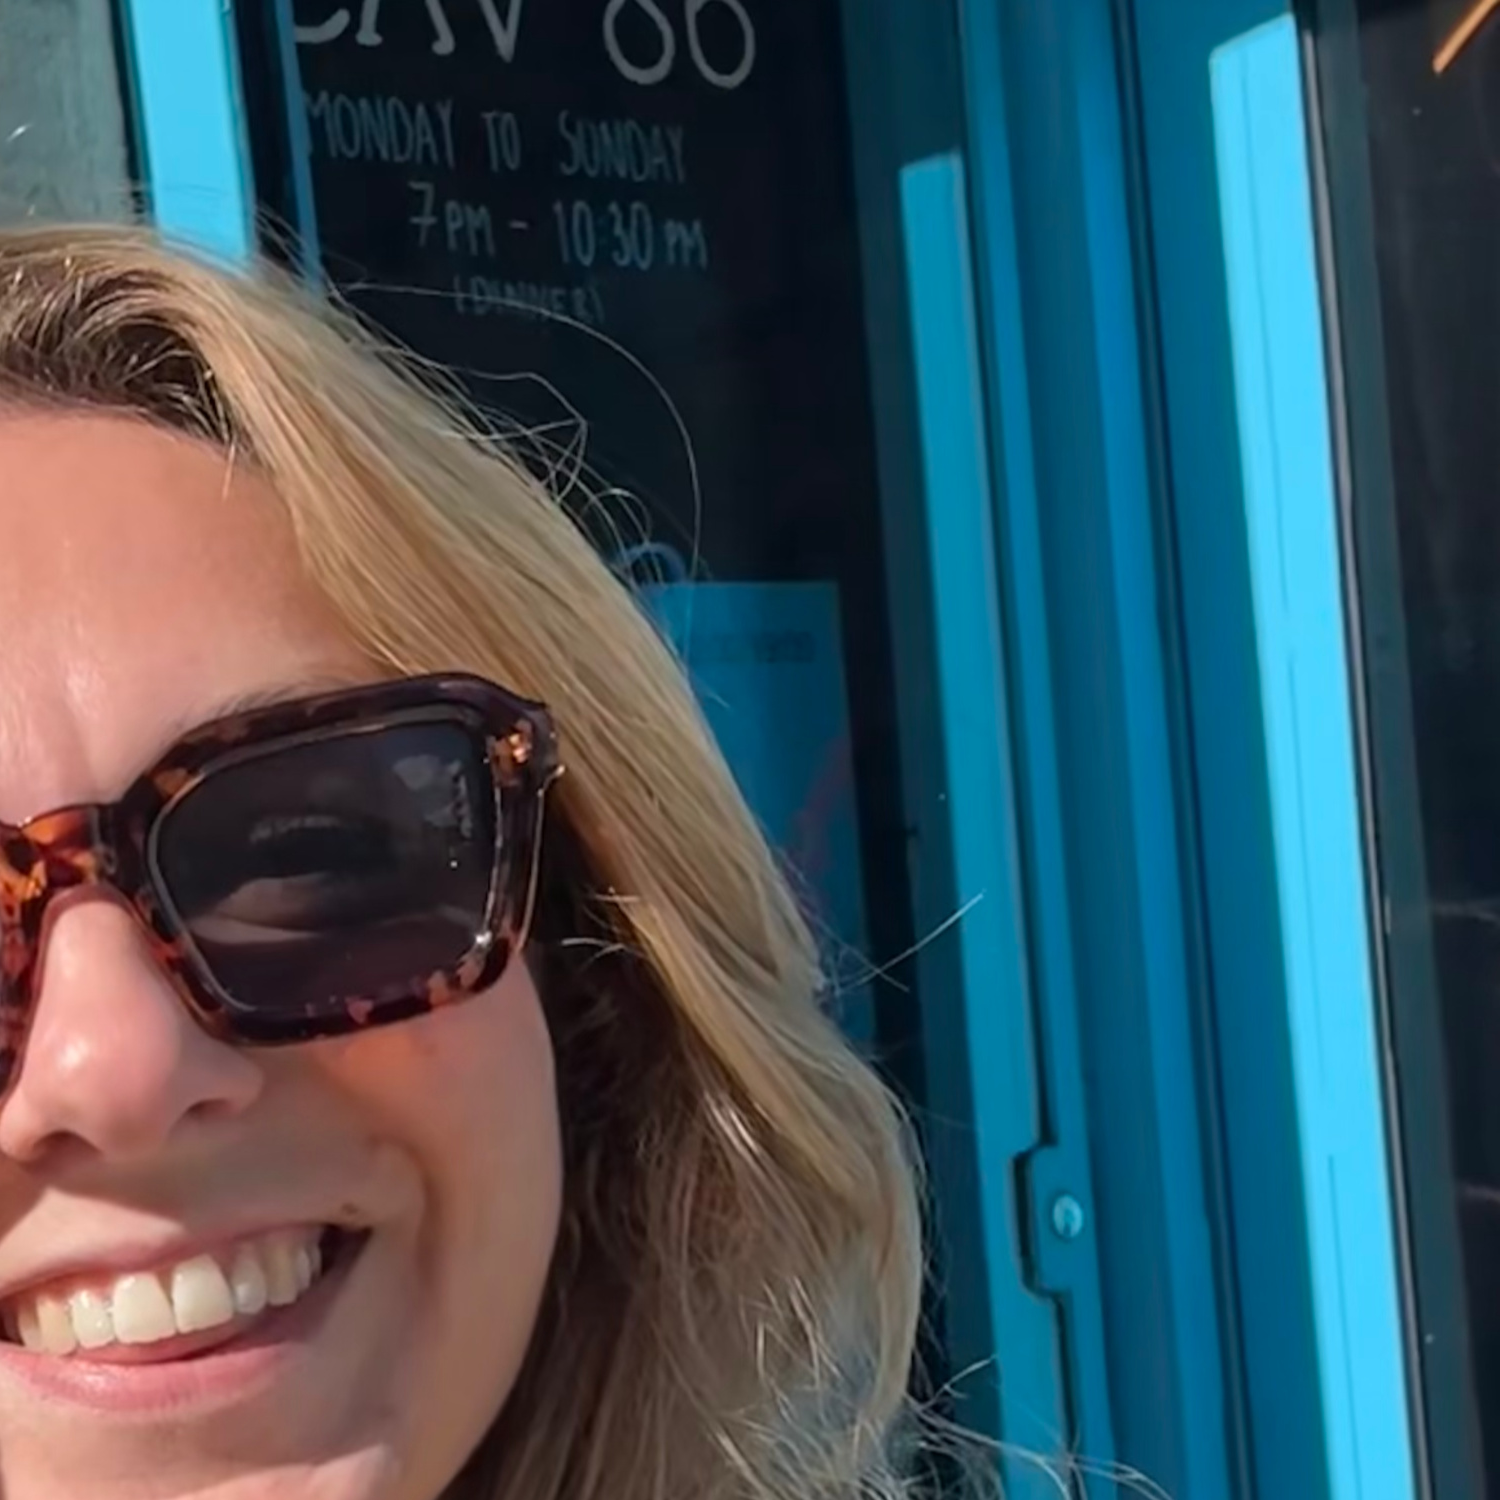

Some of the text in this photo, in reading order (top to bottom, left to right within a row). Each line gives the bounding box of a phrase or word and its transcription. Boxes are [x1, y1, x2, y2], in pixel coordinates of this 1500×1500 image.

[302, 89, 687, 184] MONDAY TO SUNDAY
